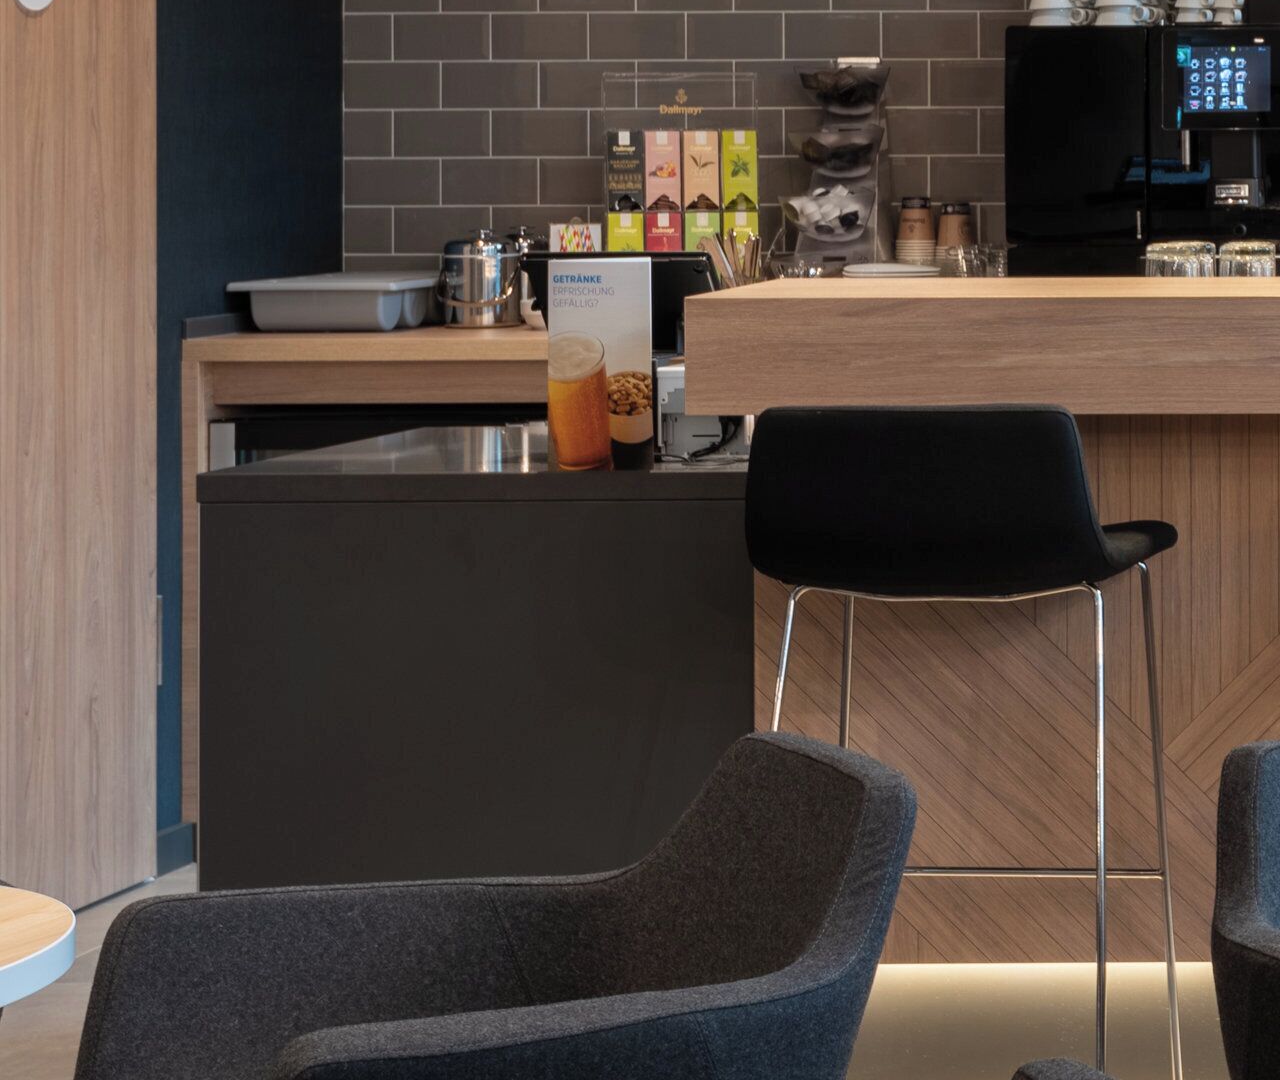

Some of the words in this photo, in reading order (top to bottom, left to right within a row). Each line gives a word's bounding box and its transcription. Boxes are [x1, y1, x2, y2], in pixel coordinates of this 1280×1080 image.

[659, 104, 704, 116] Dallmayr
[553, 273, 602, 284] GETRÄNKE
[553, 286, 615, 296] ERFRISCHUNG
[553, 298, 599, 308] GEFÄLLIG?
